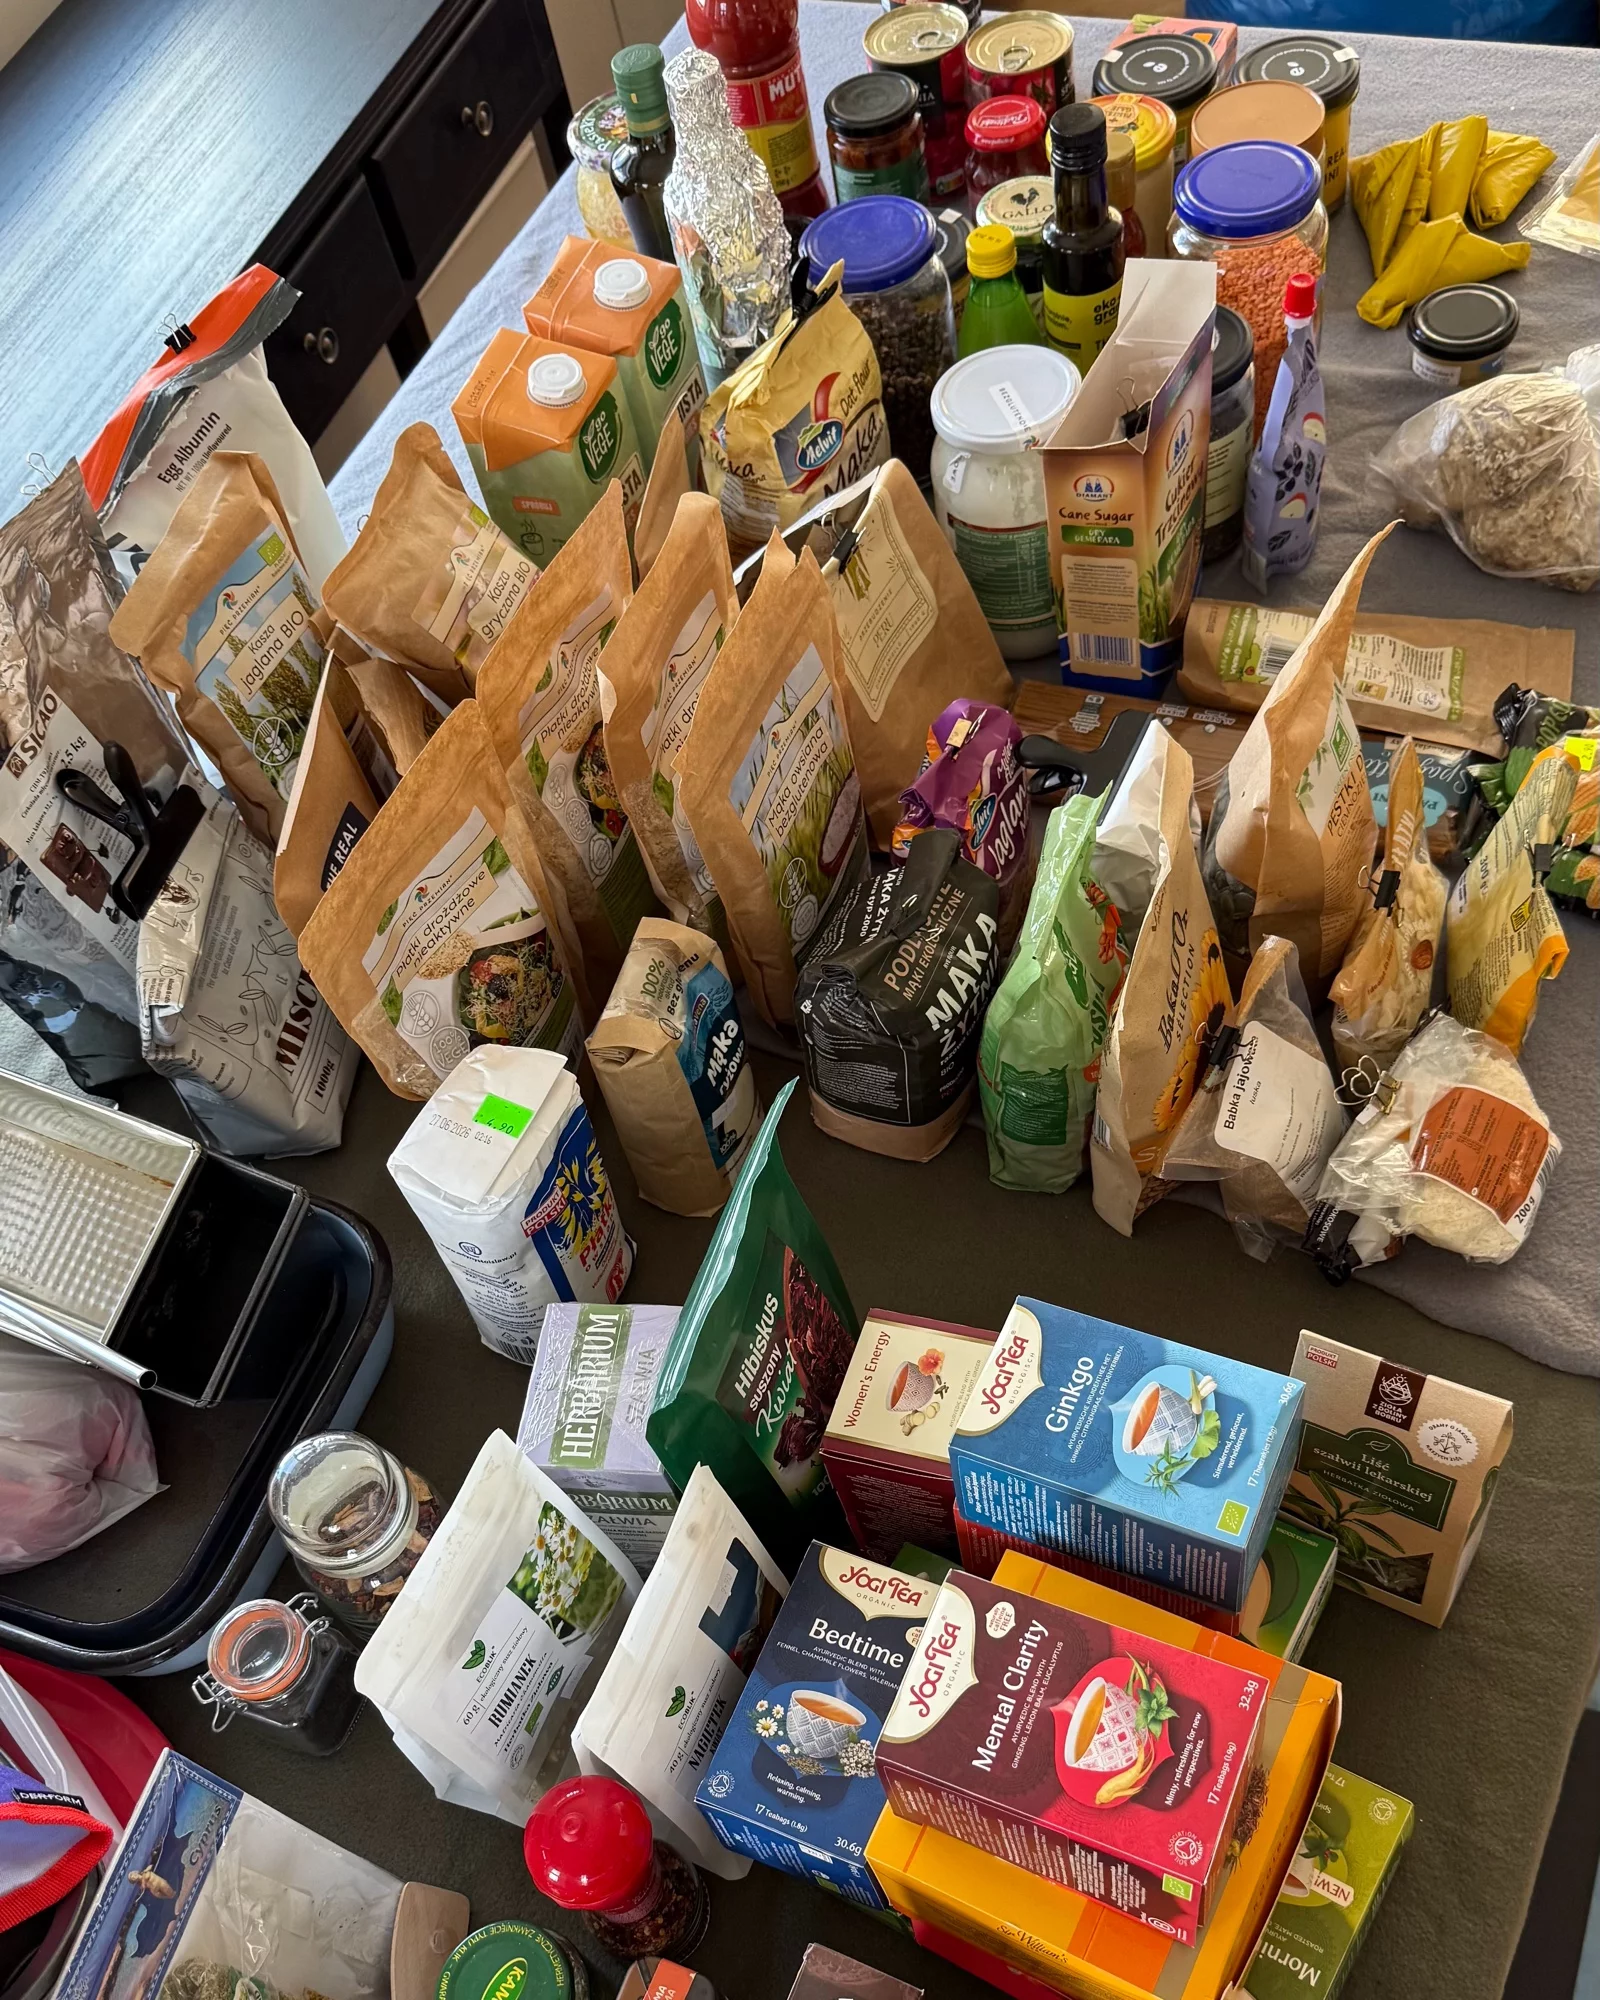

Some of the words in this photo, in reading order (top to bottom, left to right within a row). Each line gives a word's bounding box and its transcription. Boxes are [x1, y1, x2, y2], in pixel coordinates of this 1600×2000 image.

[1002, 203, 1054, 220] GALLO
[659, 318, 671, 339] go
[650, 339, 678, 376] VEGE
[594, 410, 606, 431] go
[157, 461, 181, 484] Egg
[176, 411, 221, 466] Albumin
[203, 423, 233, 462] Unflavoured
[584, 430, 616, 472] VEGE
[805, 427, 837, 465] Melvit
[1165, 454, 1196, 512] Cukier
[1059, 507, 1090, 521] Cane
[1094, 509, 1134, 525] Sugar
[482, 583, 521, 639] gryczana
[518, 560, 531, 585] BIO
[488, 571, 510, 604] Kasza
[249, 624, 275, 656] Kasza
[872, 613, 896, 649] PERU
[240, 637, 284, 694] jaglana
[281, 610, 305, 638] BIO
[540, 710, 569, 744] Płatki
[571, 647, 600, 711] drożdżowe
[20, 694, 57, 760] SICAO
[70, 736, 87, 754] kg
[768, 786, 792, 829] Mąka
[790, 726, 825, 784] owsiana
[776, 742, 830, 838] bezglutenowa
[1327, 771, 1360, 837] PESTKI
[335, 823, 358, 866] REAL
[1480, 854, 1489, 880] 300
[395, 935, 422, 978] Płatki
[423, 869, 487, 935] drożdżowe
[413, 896, 476, 968] nieaktywne
[641, 957, 665, 999] 100%
[903, 970, 926, 1002] MĄKI
[925, 912, 998, 1032] MĄKA
[666, 992, 683, 1016] Bez
[434, 1031, 463, 1052] 100%
[437, 1046, 470, 1069] VEGE
[706, 1019, 740, 1088] Mąka
[314, 1059, 337, 1099] 1000g
[719, 1039, 745, 1097] ryżowa
[429, 1113, 472, 1140] 27.06.2026
[474, 1131, 494, 1146] 02:16
[1223, 1093, 1242, 1131] Babka
[524, 1191, 561, 1228] PRODUKT
[526, 1199, 567, 1237] POLSKI
[1513, 1204, 1531, 1225] 200
[734, 1292, 779, 1399] Hibiskus
[1307, 1352, 1337, 1368] POLSKI
[560, 1312, 620, 1460] HERBARIUM
[749, 1342, 783, 1412] suszony
[755, 1337, 800, 1439] Kwiat
[843, 1373, 874, 1429] Women's
[864, 1331, 892, 1374] Energy
[981, 1366, 1009, 1415] YOGI
[999, 1334, 1030, 1367] TEA
[1009, 1352, 1036, 1405] BIOLOGISCH
[1278, 1381, 1298, 1407] 30,6g
[1045, 1356, 1094, 1433] Ginkgo
[1067, 1404, 1089, 1450] AYURVEDISCHE
[1103, 1353, 1112, 1368] MET
[1378, 1405, 1408, 1421] DOLINY
[1379, 1400, 1403, 1413] ZIOŁA
[1374, 1409, 1403, 1424] BOBRU
[1247, 1473, 1260, 1488] 17
[1313, 1446, 1362, 1473] szałwii
[1364, 1465, 1433, 1504] lekarskiej
[1361, 1453, 1390, 1472] Liść
[1323, 1469, 1370, 1497] HERBATKA
[1373, 1490, 1415, 1513] ZIOŁOWA
[839, 1565, 887, 1594] YOGI
[887, 1576, 923, 1607] TEA
[856, 1592, 897, 1611] ORGANIC
[1000, 1612, 1013, 1632] FREE
[808, 1618, 905, 1669] Bedtime
[813, 1645, 848, 1664] AYURVEDIC
[848, 1658, 868, 1671] BLEND
[868, 1665, 886, 1677] WITH
[476, 1650, 497, 1684] ECOBLIK
[480, 1664, 504, 1702] ekologiczny
[511, 1625, 529, 1653] ziołowy
[776, 1640, 801, 1655] FENNEL,
[801, 1649, 837, 1669] CHAMOMILE
[835, 1662, 867, 1680] FLOWERS,
[868, 1674, 900, 1691] VALERIAN
[908, 1655, 945, 1718] YOGI
[927, 1621, 962, 1661] TEA
[943, 1649, 966, 1697] ORGANIC
[488, 1654, 537, 1729] RUMIANEK
[971, 1693, 1016, 1772] Mental
[1003, 1619, 1049, 1691] Clarity
[1011, 1702, 1031, 1744] AYURVEDIC
[1026, 1678, 1039, 1703] BLEND
[1035, 1658, 1047, 1679] WITH
[1011, 1736, 1029, 1769] GINSENG,
[1025, 1709, 1038, 1735] LEMON
[1034, 1686, 1047, 1710] BALM,
[1042, 1641, 1064, 1686] EUCALYPTUS
[1238, 1680, 1261, 1711] 32.3g
[463, 1708, 476, 1726] 60
[678, 1694, 695, 1730] ECOBLIK
[684, 1708, 704, 1749] ekologiczny
[687, 1696, 728, 1772] NAGIETEK
[668, 1758, 680, 1775] 40
[1164, 1781, 1179, 1807] Minty,
[1173, 1741, 1191, 1785] refreshing,
[1190, 1711, 1203, 1731] new
[1183, 1738, 1206, 1788] perspectives.
[20, 1790, 83, 1807] DERFORM
[766, 1772, 796, 1791] Relaxing,
[794, 1782, 822, 1802] calming,
[776, 1786, 806, 1804] warming.
[1206, 1788, 1220, 1805] 17
[1213, 1758, 1233, 1793] Teabags
[754, 1803, 765, 1815] 17
[765, 1808, 791, 1825] Teabags
[189, 1804, 223, 1867] Cyprus
[834, 1836, 863, 1855] 30.6g
[1313, 1874, 1351, 1902] NEW!
[452, 1945, 469, 1963] KLIK
[467, 1929, 489, 1947] TYPU
[996, 1924, 1016, 1939] Sir
[1014, 1927, 1069, 1962] William's
[1299, 1935, 1325, 1954] ROASTED
[1259, 1940, 1322, 1988] Morni
